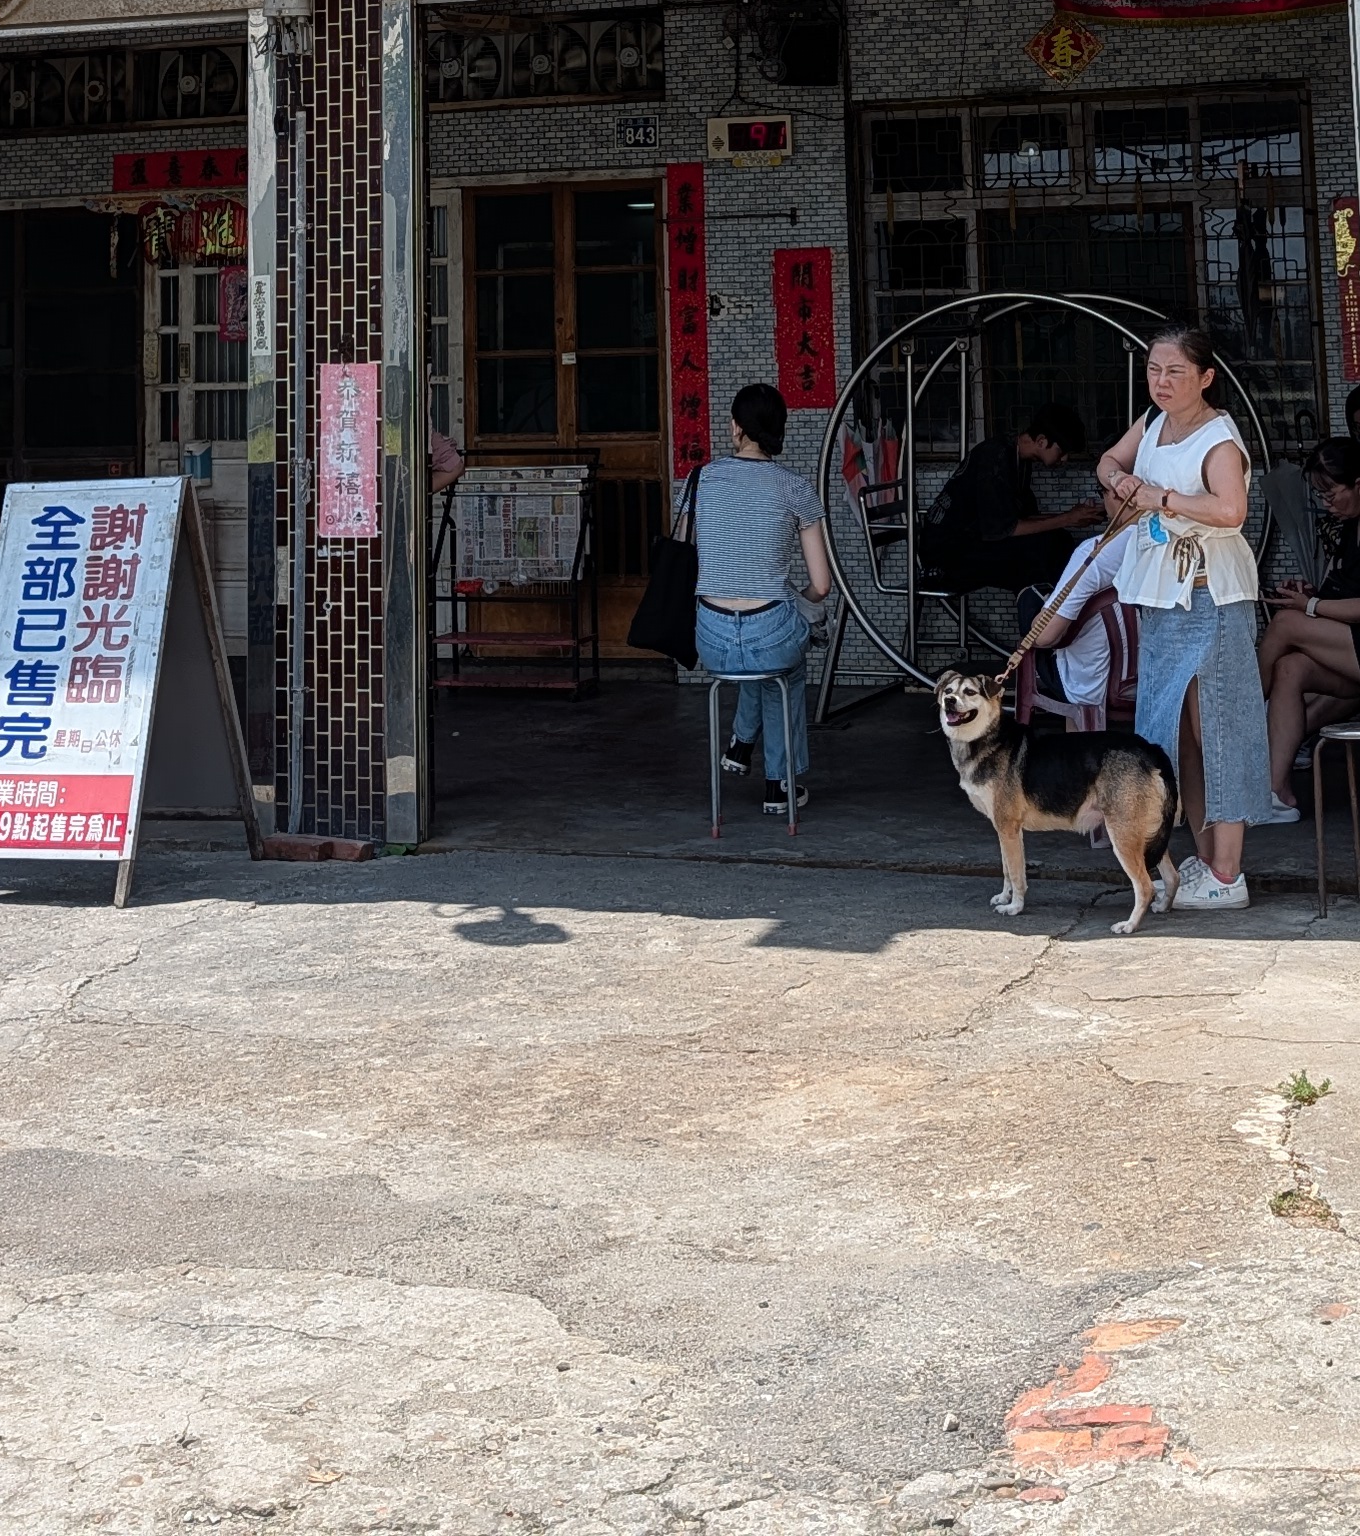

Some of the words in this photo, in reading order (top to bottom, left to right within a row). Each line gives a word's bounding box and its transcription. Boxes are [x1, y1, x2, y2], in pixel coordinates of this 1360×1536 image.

[1051, 26, 1081, 69] 春
[626, 126, 656, 145] 843
[65, 502, 149, 705] 謝謝光臨
[53, 729, 123, 754] 星期日公休
